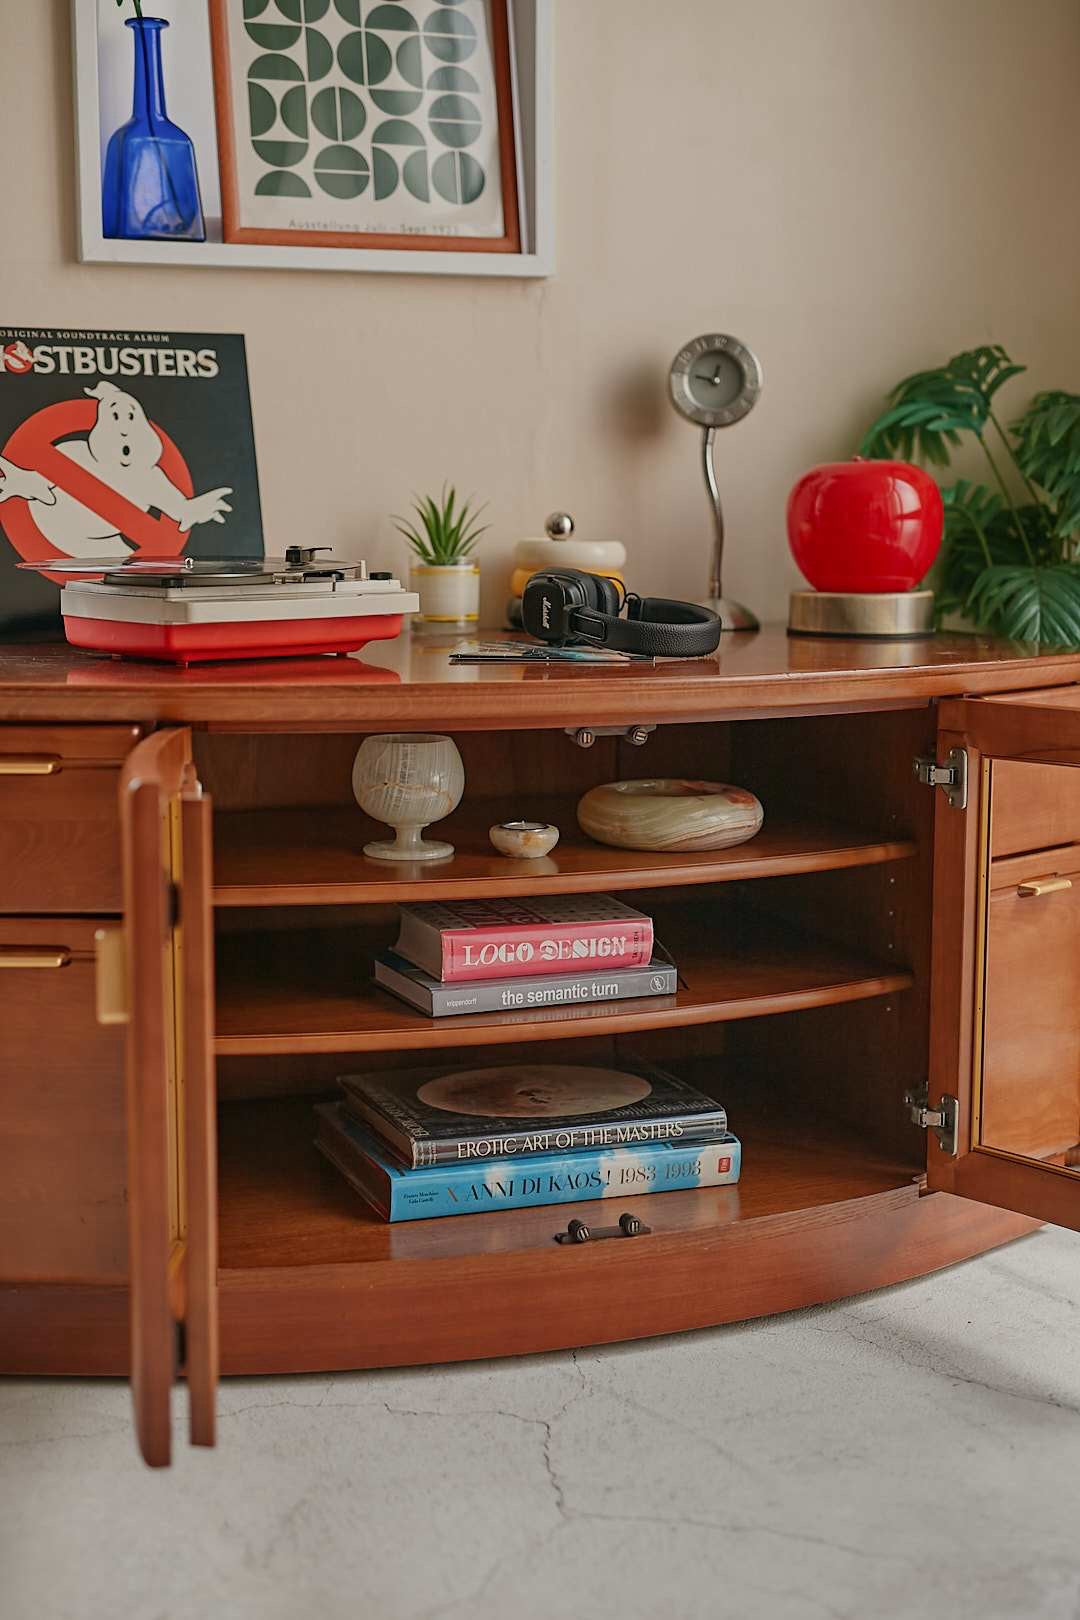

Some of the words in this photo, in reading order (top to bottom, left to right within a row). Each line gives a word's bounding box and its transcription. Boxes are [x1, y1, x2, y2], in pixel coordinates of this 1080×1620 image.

[0, 330, 53, 339] ORIGINAL
[56, 331, 132, 342] SOUNDTRACK
[133, 333, 170, 343] ALBUM
[462, 942, 534, 967] LOGO
[539, 935, 628, 960] DESIGN
[502, 989, 525, 1006] the
[527, 983, 588, 1003] semantic
[591, 982, 619, 998] turn
[457, 1139, 518, 1159] EROTIC
[521, 1135, 553, 1152] ART
[555, 1131, 581, 1149] OF
[582, 1128, 612, 1145] THE
[616, 1121, 684, 1143] MASTERS
[465, 1180, 514, 1203] ANNI
[522, 1177, 544, 1197] DI
[618, 1165, 657, 1185] 1983
[665, 1159, 702, 1179] 1993
